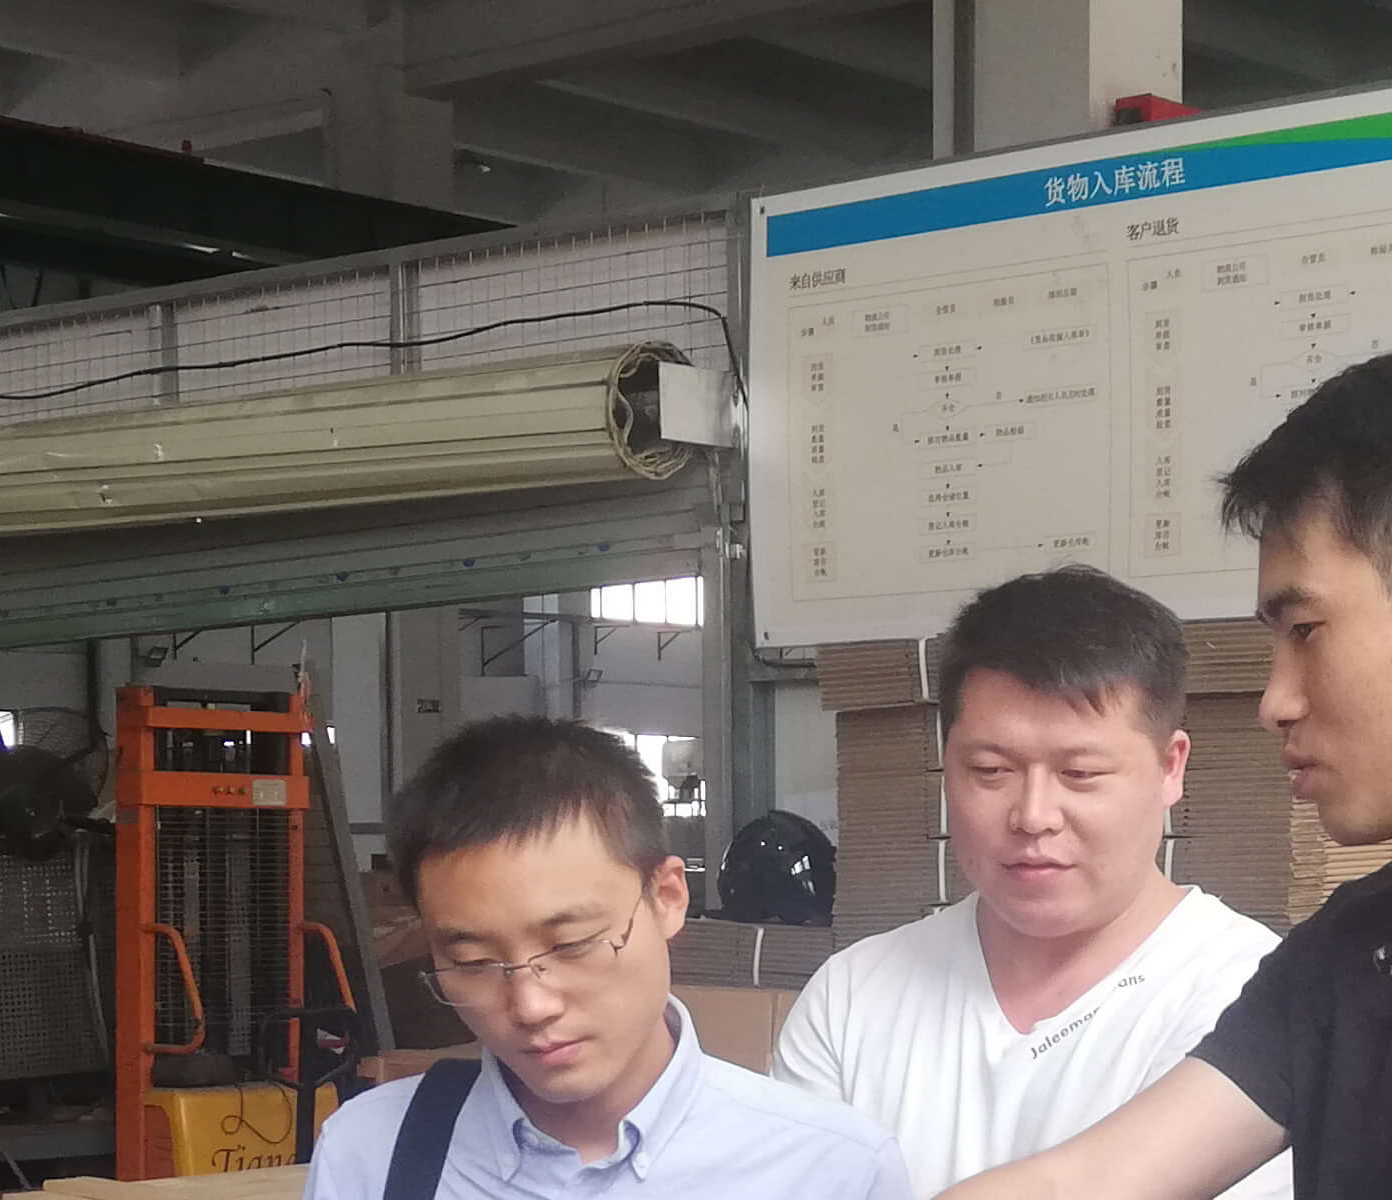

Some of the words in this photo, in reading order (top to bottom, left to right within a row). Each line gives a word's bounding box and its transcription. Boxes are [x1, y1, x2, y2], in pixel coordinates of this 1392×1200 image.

[1043, 157, 1187, 208] 货物入库流程
[1127, 217, 1180, 241] 客户退货
[789, 269, 846, 290] 来自供应商
